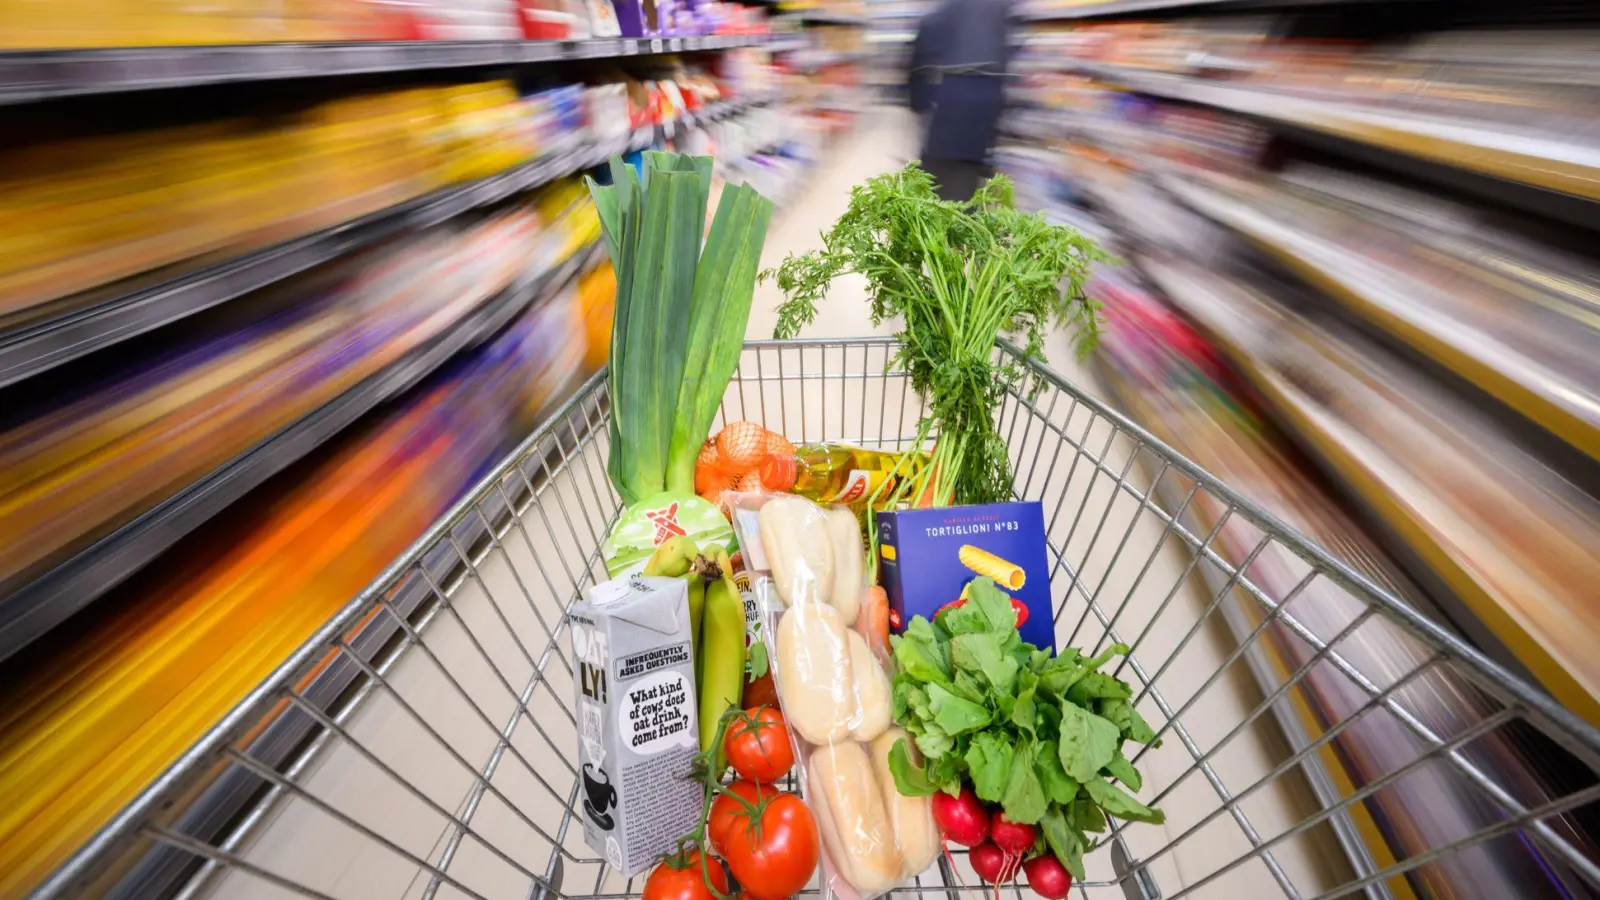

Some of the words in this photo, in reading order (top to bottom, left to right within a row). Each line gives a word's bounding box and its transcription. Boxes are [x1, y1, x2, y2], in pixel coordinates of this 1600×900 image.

[925, 523, 990, 538] TORTIGLIONI
[619, 664, 645, 678] ASKED
[646, 652, 689, 670] QUESTIONS
[625, 645, 684, 668] INFREQUENTLY
[580, 661, 607, 704] LY!
[629, 686, 658, 705] What
[659, 678, 682, 697] kind
[629, 704, 641, 720] of
[642, 700, 664, 717] cows
[665, 692, 686, 707] does
[633, 716, 651, 732] oat
[652, 706, 682, 726] drink
[632, 729, 658, 747] come
[658, 714, 689, 738] from?
